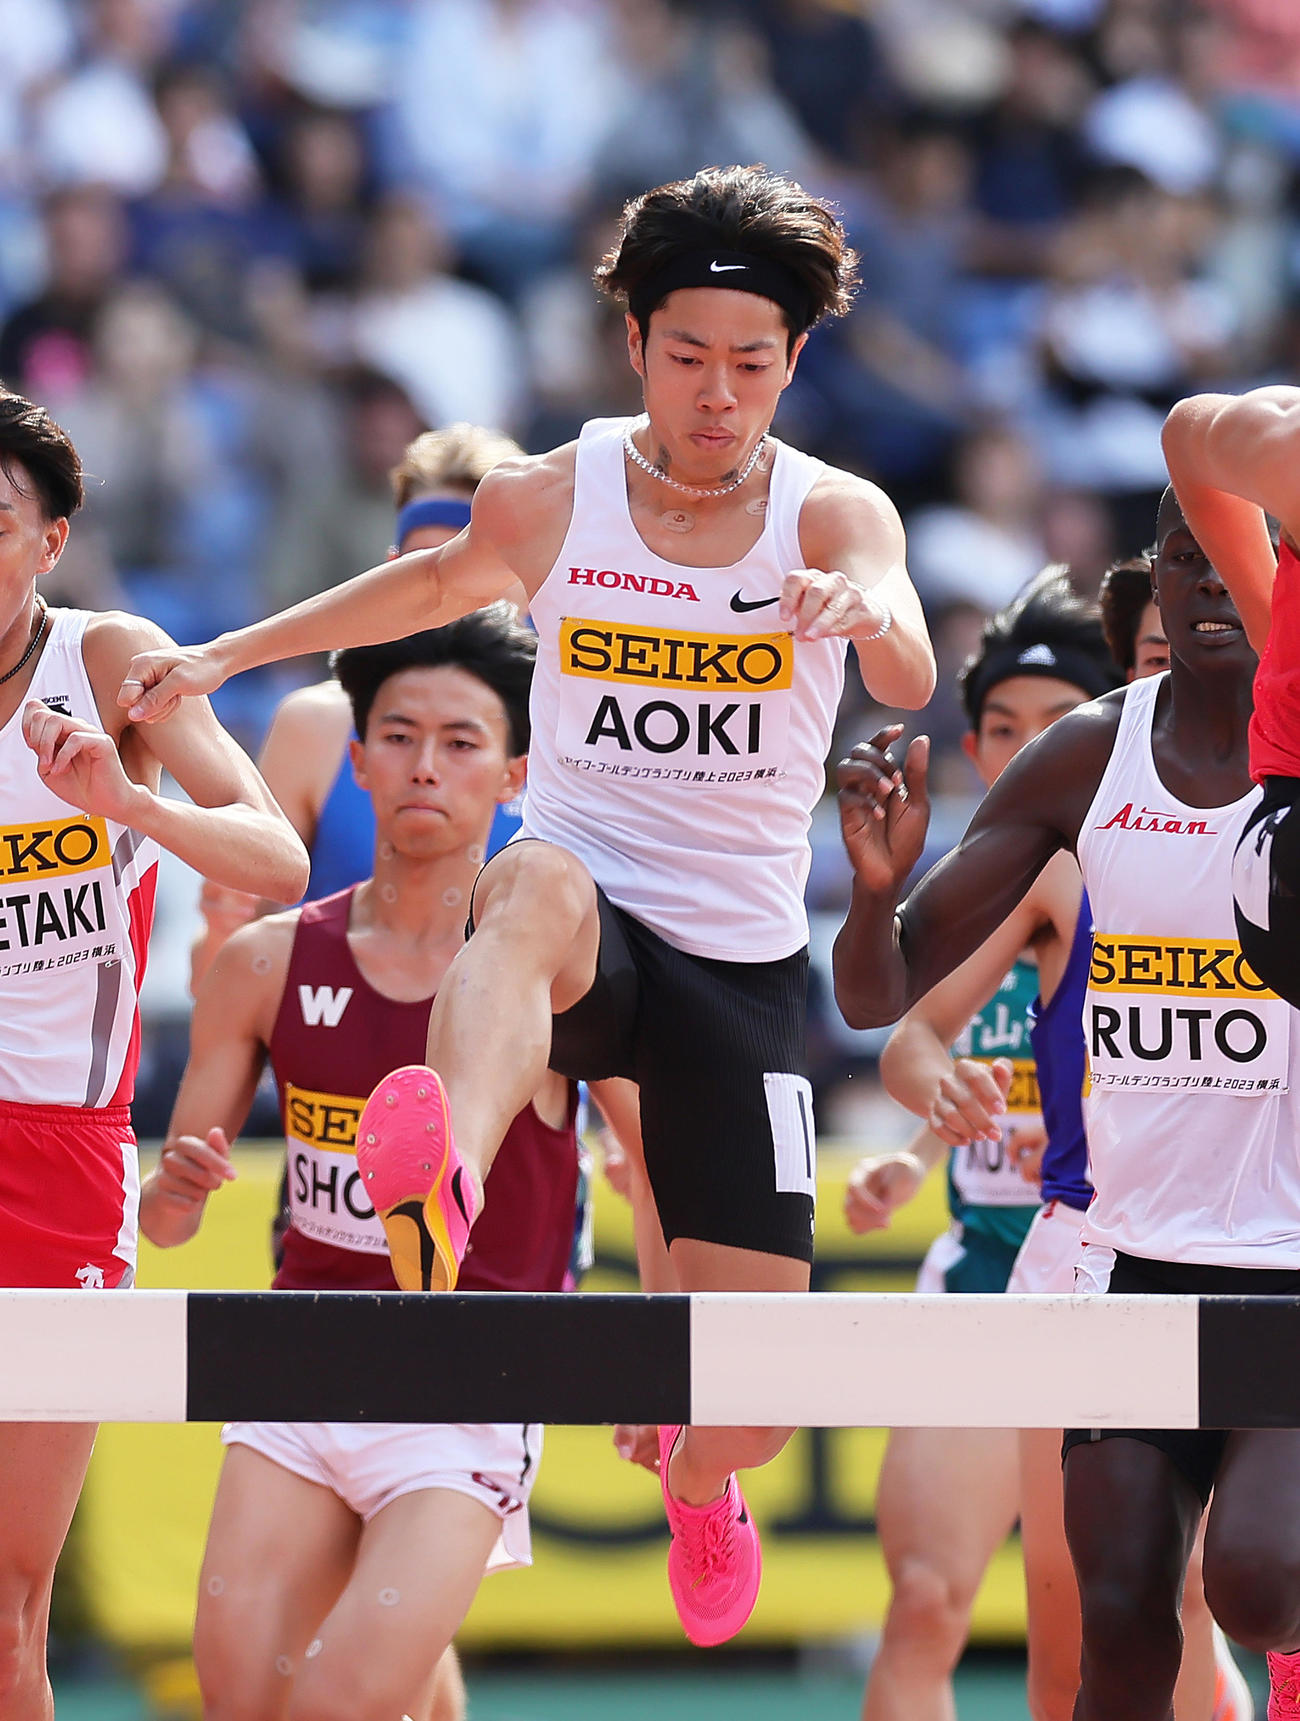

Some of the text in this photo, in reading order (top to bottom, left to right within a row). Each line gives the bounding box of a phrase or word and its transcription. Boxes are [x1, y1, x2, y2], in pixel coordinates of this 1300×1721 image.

[566, 567, 701, 602] HONDA
[570, 627, 782, 685] SEIKO
[584, 694, 761, 756] AOKI
[1094, 802, 1218, 835] Aisan
[0, 824, 99, 876] KO
[298, 984, 354, 1028] W
[1092, 1004, 1268, 1063] RUTO
